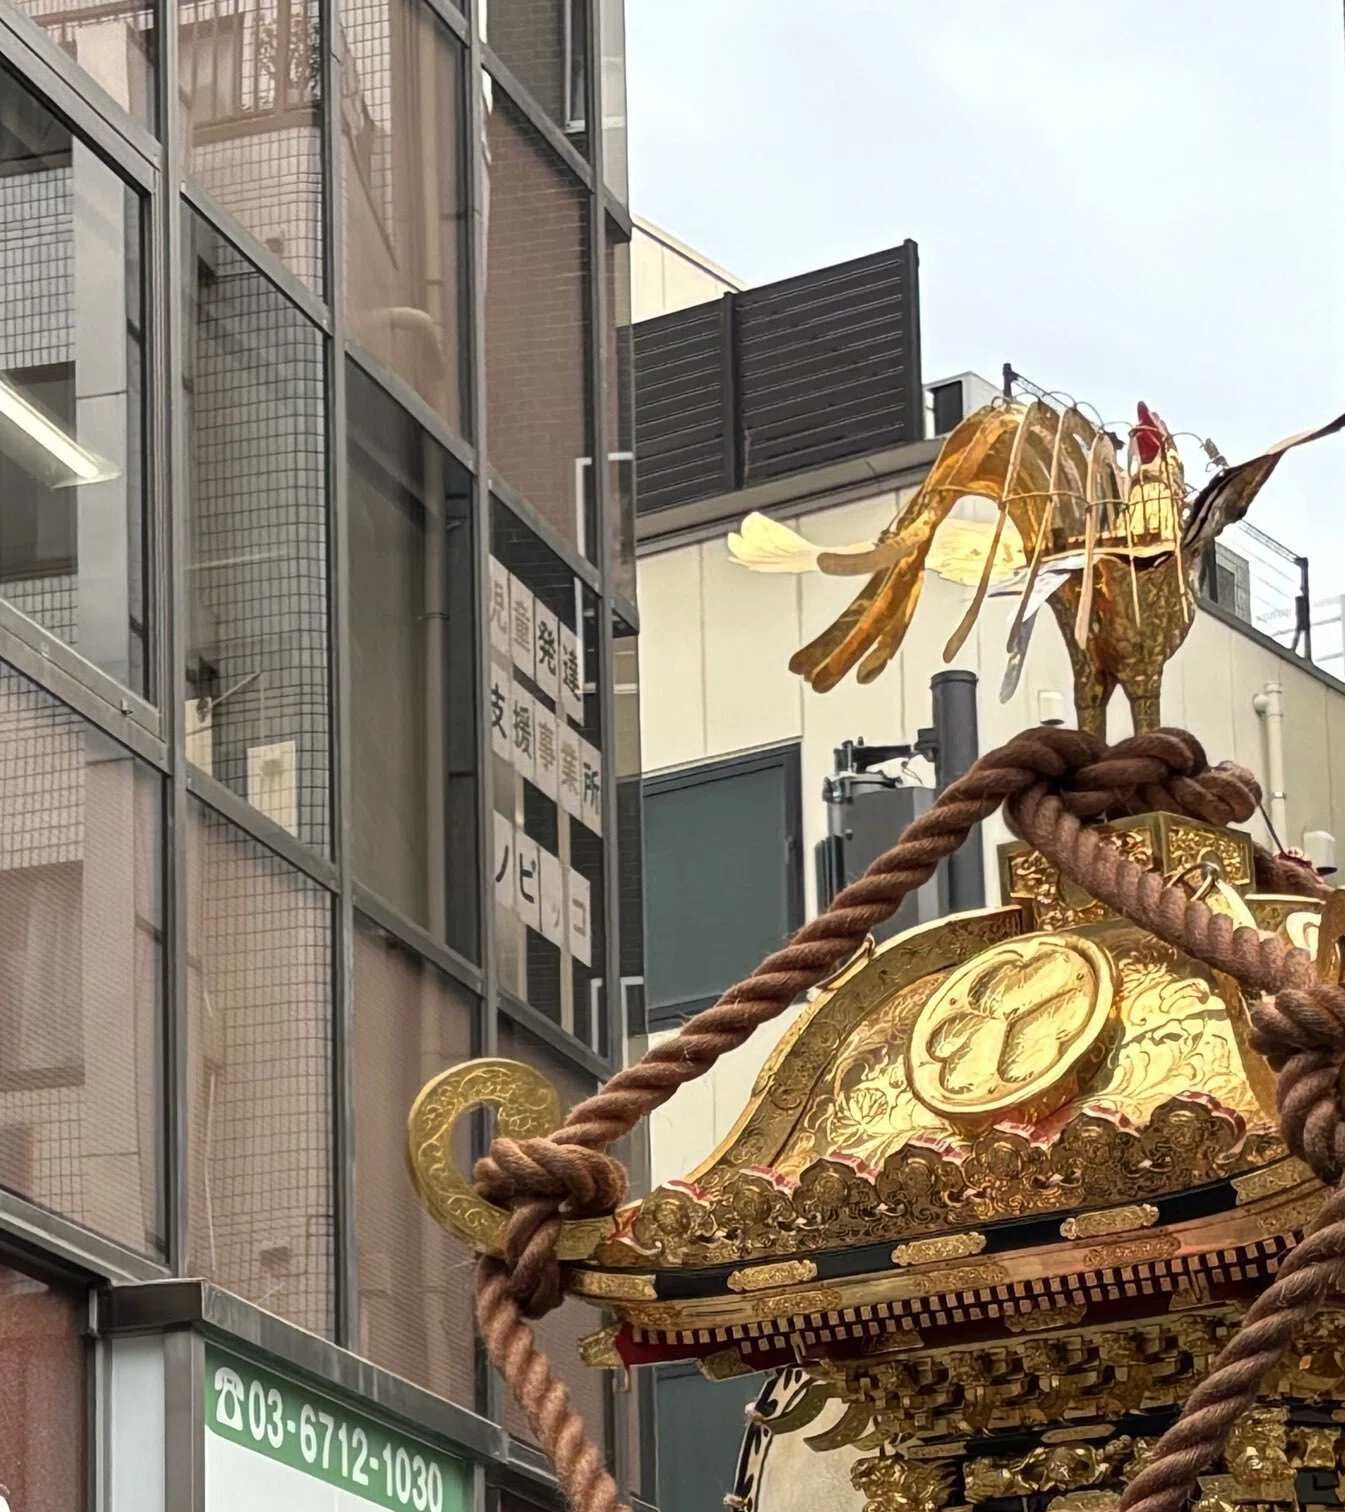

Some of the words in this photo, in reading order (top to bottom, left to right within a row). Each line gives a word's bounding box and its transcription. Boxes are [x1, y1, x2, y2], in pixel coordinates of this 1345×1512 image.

[491, 683, 600, 816] 支援事業所
